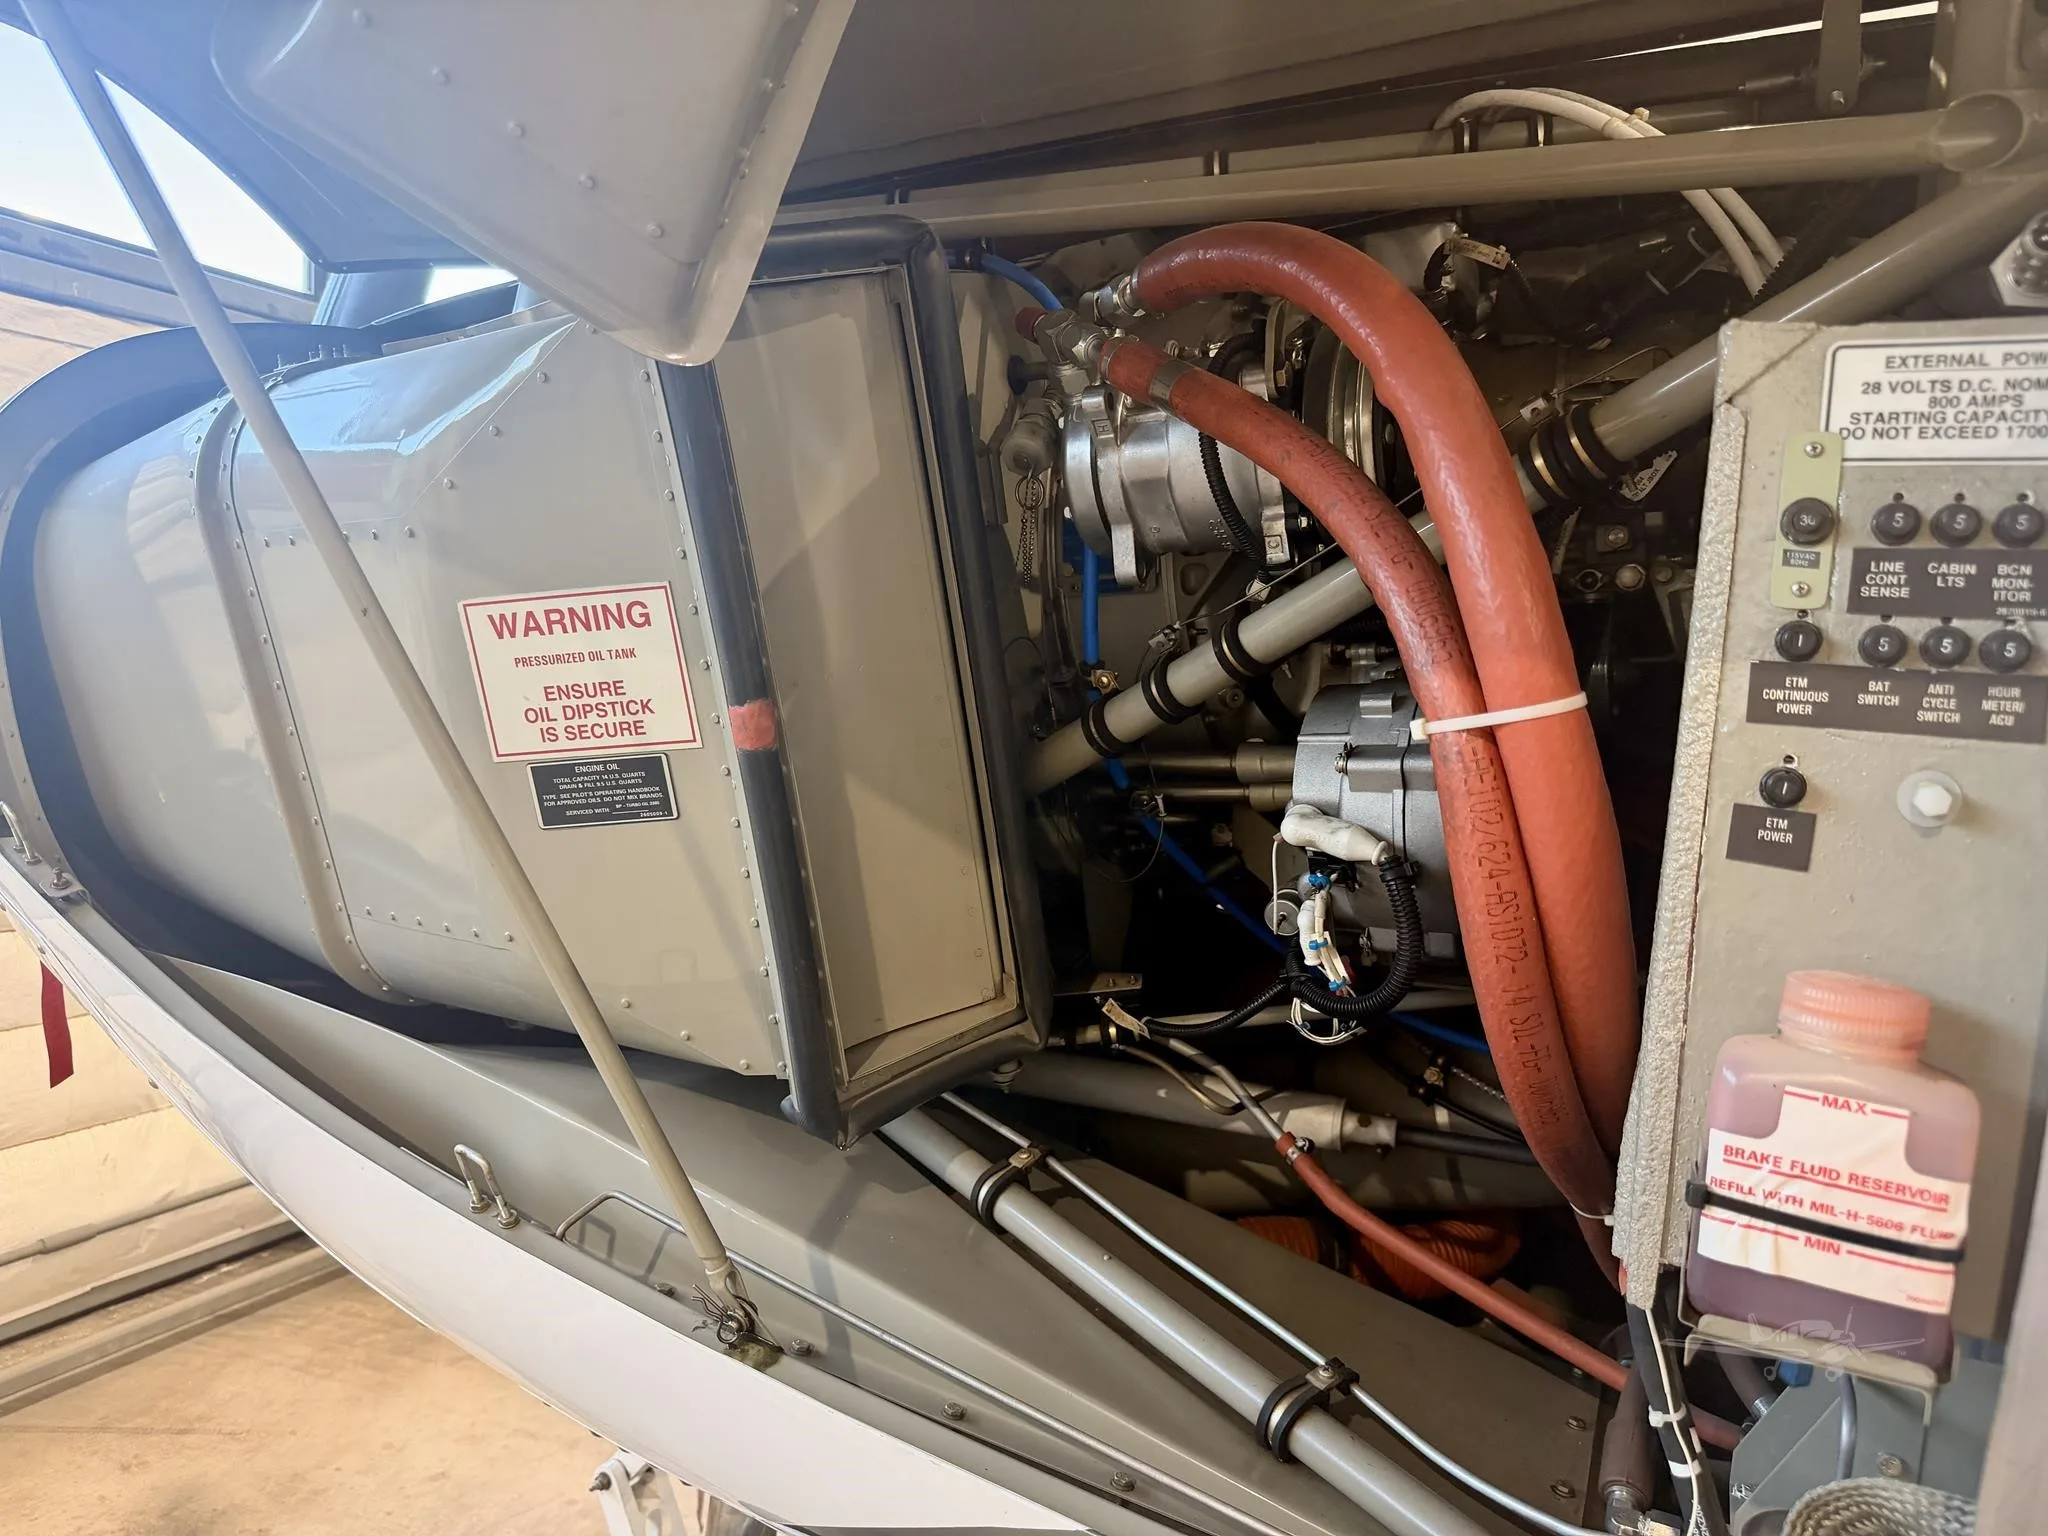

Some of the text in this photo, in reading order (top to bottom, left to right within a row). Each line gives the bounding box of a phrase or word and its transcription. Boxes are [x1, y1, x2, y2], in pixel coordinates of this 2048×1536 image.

[1885, 353, 1989, 370] EXTERNAL
[1861, 381, 1882, 395] 28
[1888, 379, 1951, 394] VOLTS
[1958, 378, 1997, 393] D.C.
[1928, 394, 2025, 410] 800 AMPS
[1849, 410, 1947, 426] STARTING
[1838, 426, 1865, 440] DO
[1871, 426, 1912, 440] NOT
[1918, 425, 1999, 440] EXCEED
[1892, 513, 1904, 527] 5
[1953, 514, 1967, 529] 5
[2015, 514, 2030, 530] 5
[1870, 561, 1905, 573] LINE
[1927, 563, 1977, 575] CABIN
[1997, 564, 2033, 576] BCN
[1865, 574, 1908, 585] CONT
[1936, 576, 1965, 588] LTS
[1860, 586, 1910, 598] SENSE
[1993, 590, 2032, 602] ITOR
[487, 600, 653, 640] WARNING
[1878, 638, 1889, 652] 5
[1940, 638, 1953, 653] 5
[2004, 643, 2017, 657] 5
[514, 647, 637, 668] PRESSURIZED OIL TANK
[1785, 677, 1808, 688] ETM
[1868, 681, 1890, 693] BAT
[543, 680, 627, 702] ENSURE
[1762, 689, 1829, 703] CONTINUOUS
[1927, 684, 1955, 696] ANTI
[1987, 686, 2021, 698] HOUR
[1857, 694, 1900, 707] SWITCH
[1922, 697, 1957, 710] CYCLE
[524, 698, 656, 723] OIL DIPSTICK
[1776, 702, 1812, 715] POWER
[1916, 710, 1961, 724] SWITCH
[540, 720, 647, 743] IS SECURE
[575, 763, 620, 773] ENGINE OIL
[594, 788, 627, 796] OPERATING
[627, 786, 660, 794] HANDBOOK
[557, 798, 587, 806] APPROVED
[565, 808, 594, 816] SERVICED
[1765, 817, 1788, 829] ETM
[1757, 829, 1793, 843] POWER
[1821, 1095, 1869, 1116] MAX
[1723, 1144, 1951, 1206] BRAKE FLUID RESERVOIR
[1709, 1175, 1756, 1197] REFILL
[1762, 1189, 1804, 1208] WITH
[1803, 1236, 1842, 1256] MIN
